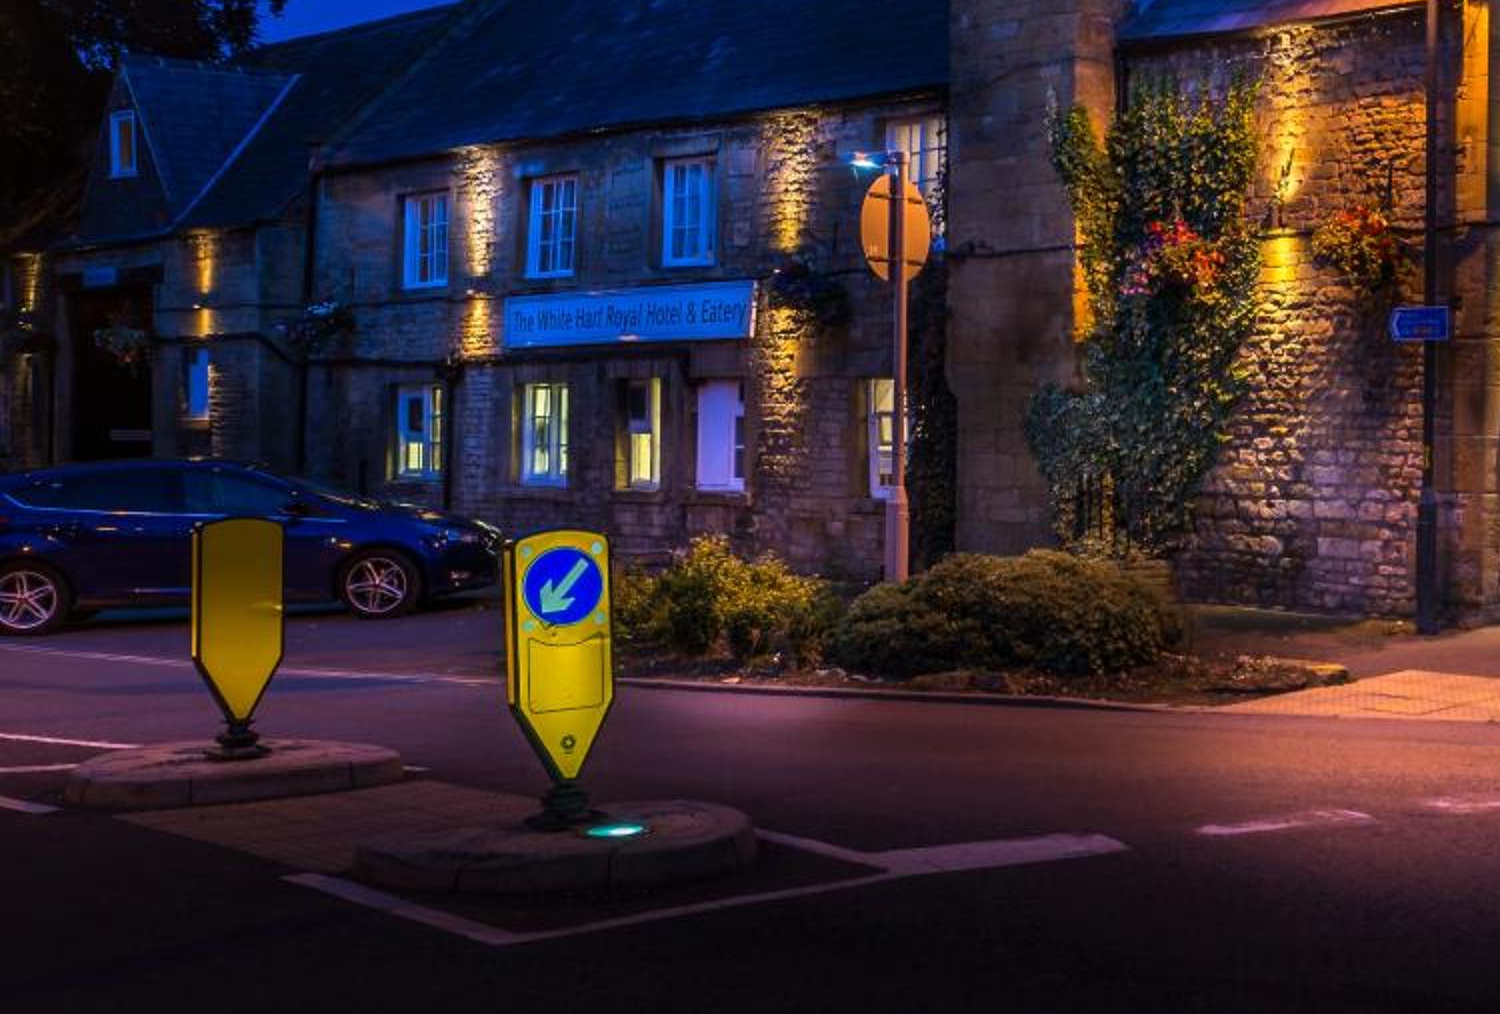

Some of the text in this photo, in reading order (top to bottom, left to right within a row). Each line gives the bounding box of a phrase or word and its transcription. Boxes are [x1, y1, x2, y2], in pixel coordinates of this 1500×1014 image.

[514, 297, 748, 332] The White Hart Royal Hotel & Eatery
